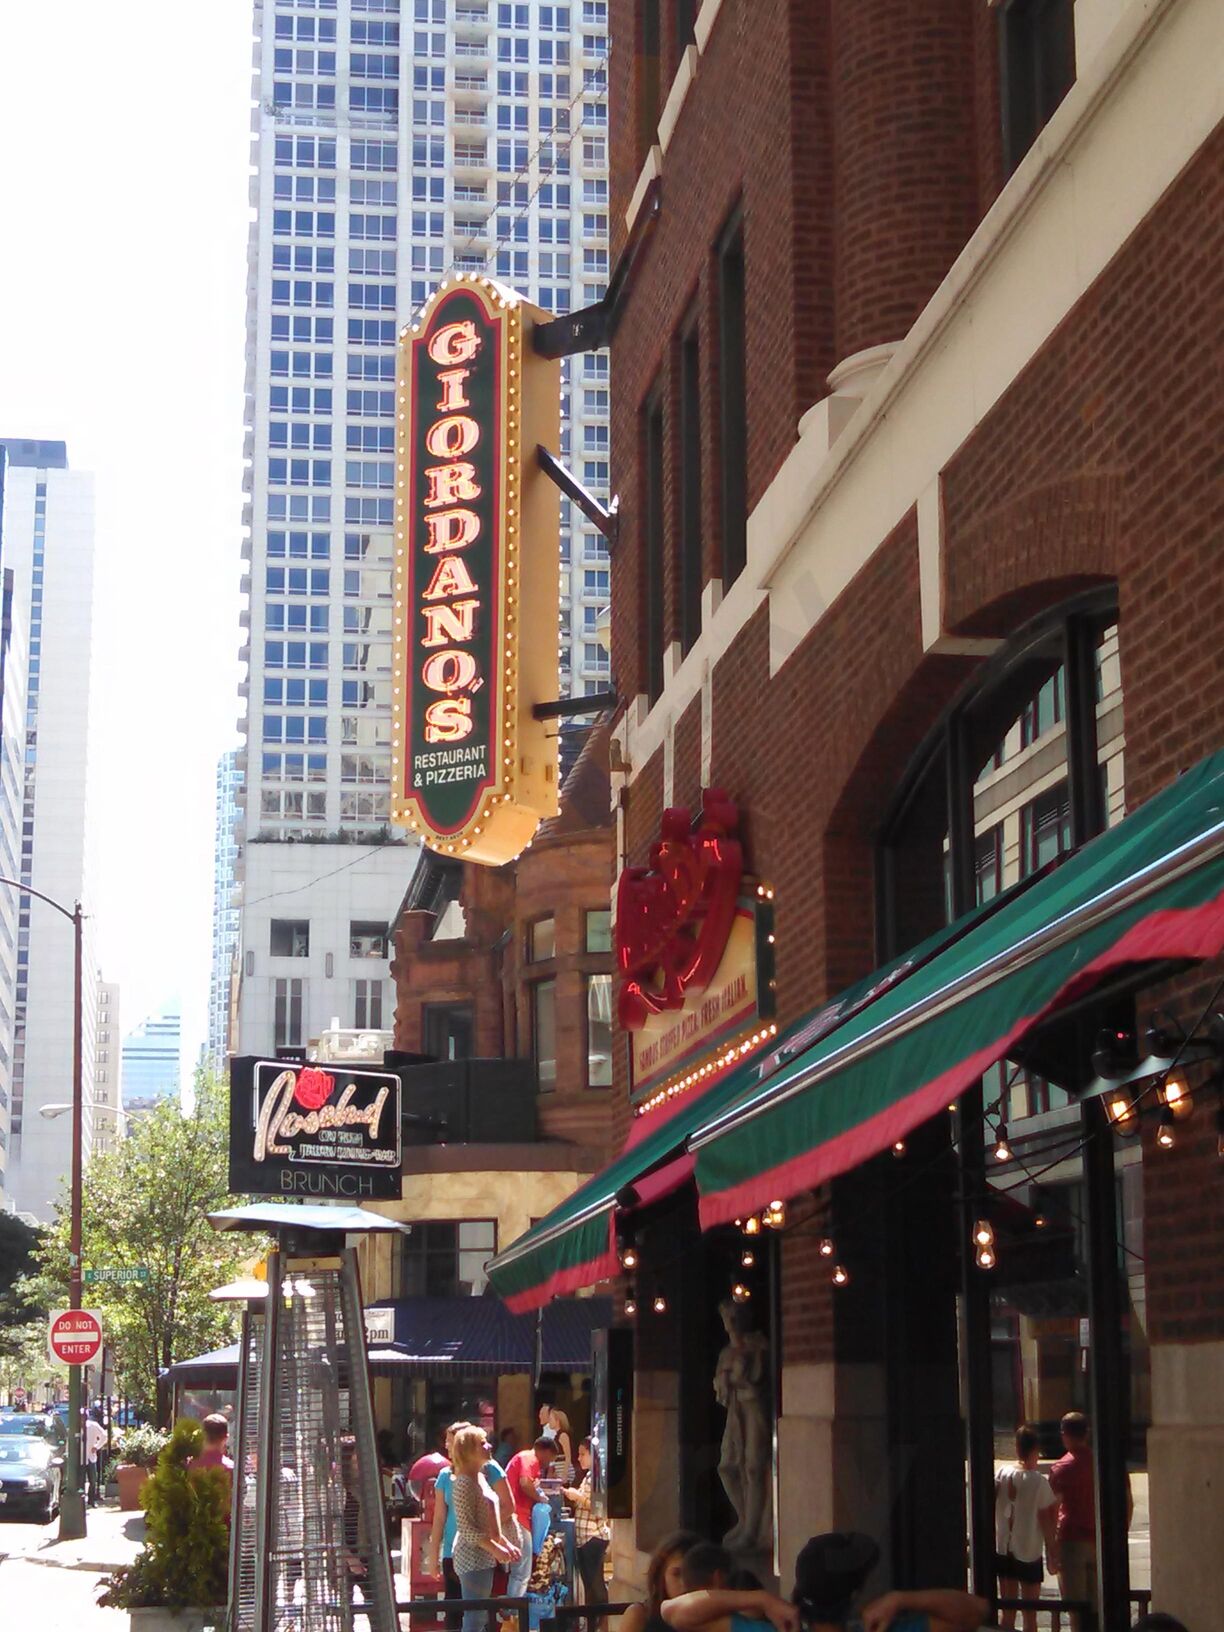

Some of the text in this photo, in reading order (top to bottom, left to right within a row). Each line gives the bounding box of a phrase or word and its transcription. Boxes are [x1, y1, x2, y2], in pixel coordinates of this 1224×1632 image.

[421, 320, 484, 743] GIORDANO'S
[414, 745, 487, 769] RESTAURANT
[414, 763, 486, 787] & PIZZERIA
[253, 1070, 389, 1162] Rosebud
[280, 1169, 373, 1196] BRUNCH
[93, 1270, 139, 1281] SUPERIOR
[59, 1321, 93, 1330] DO NOT
[61, 1344, 91, 1354] ENTER
